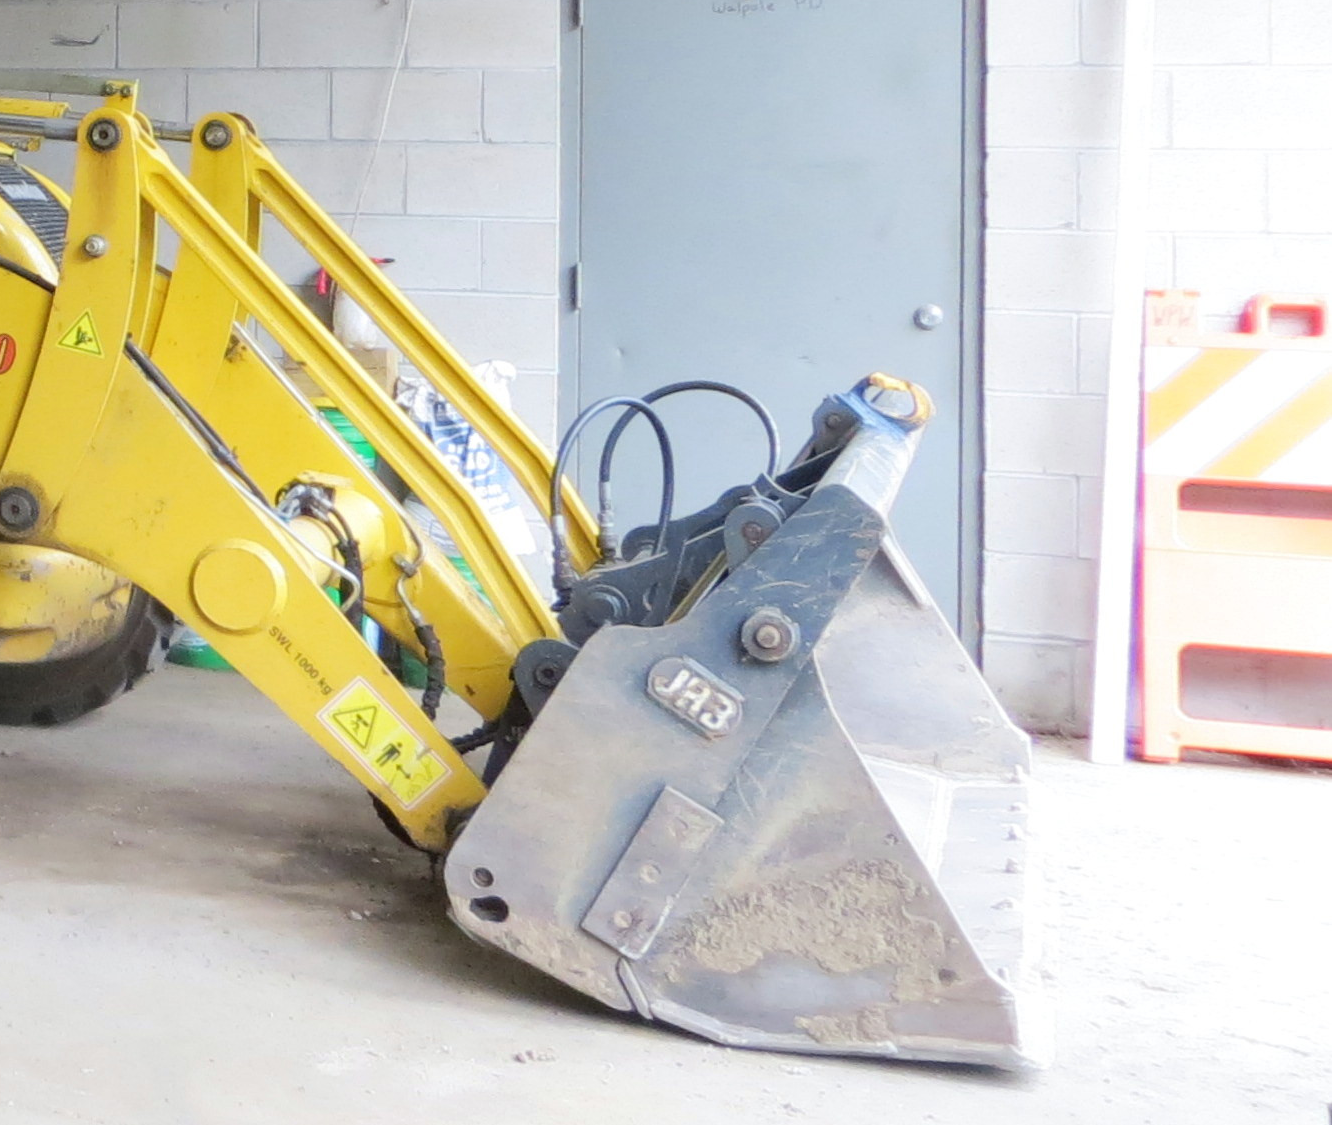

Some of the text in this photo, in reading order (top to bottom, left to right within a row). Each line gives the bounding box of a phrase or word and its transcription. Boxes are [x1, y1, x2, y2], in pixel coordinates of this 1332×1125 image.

[711, 0, 776, 19] Walpole
[268, 625, 334, 696] SWL 1000 kg
